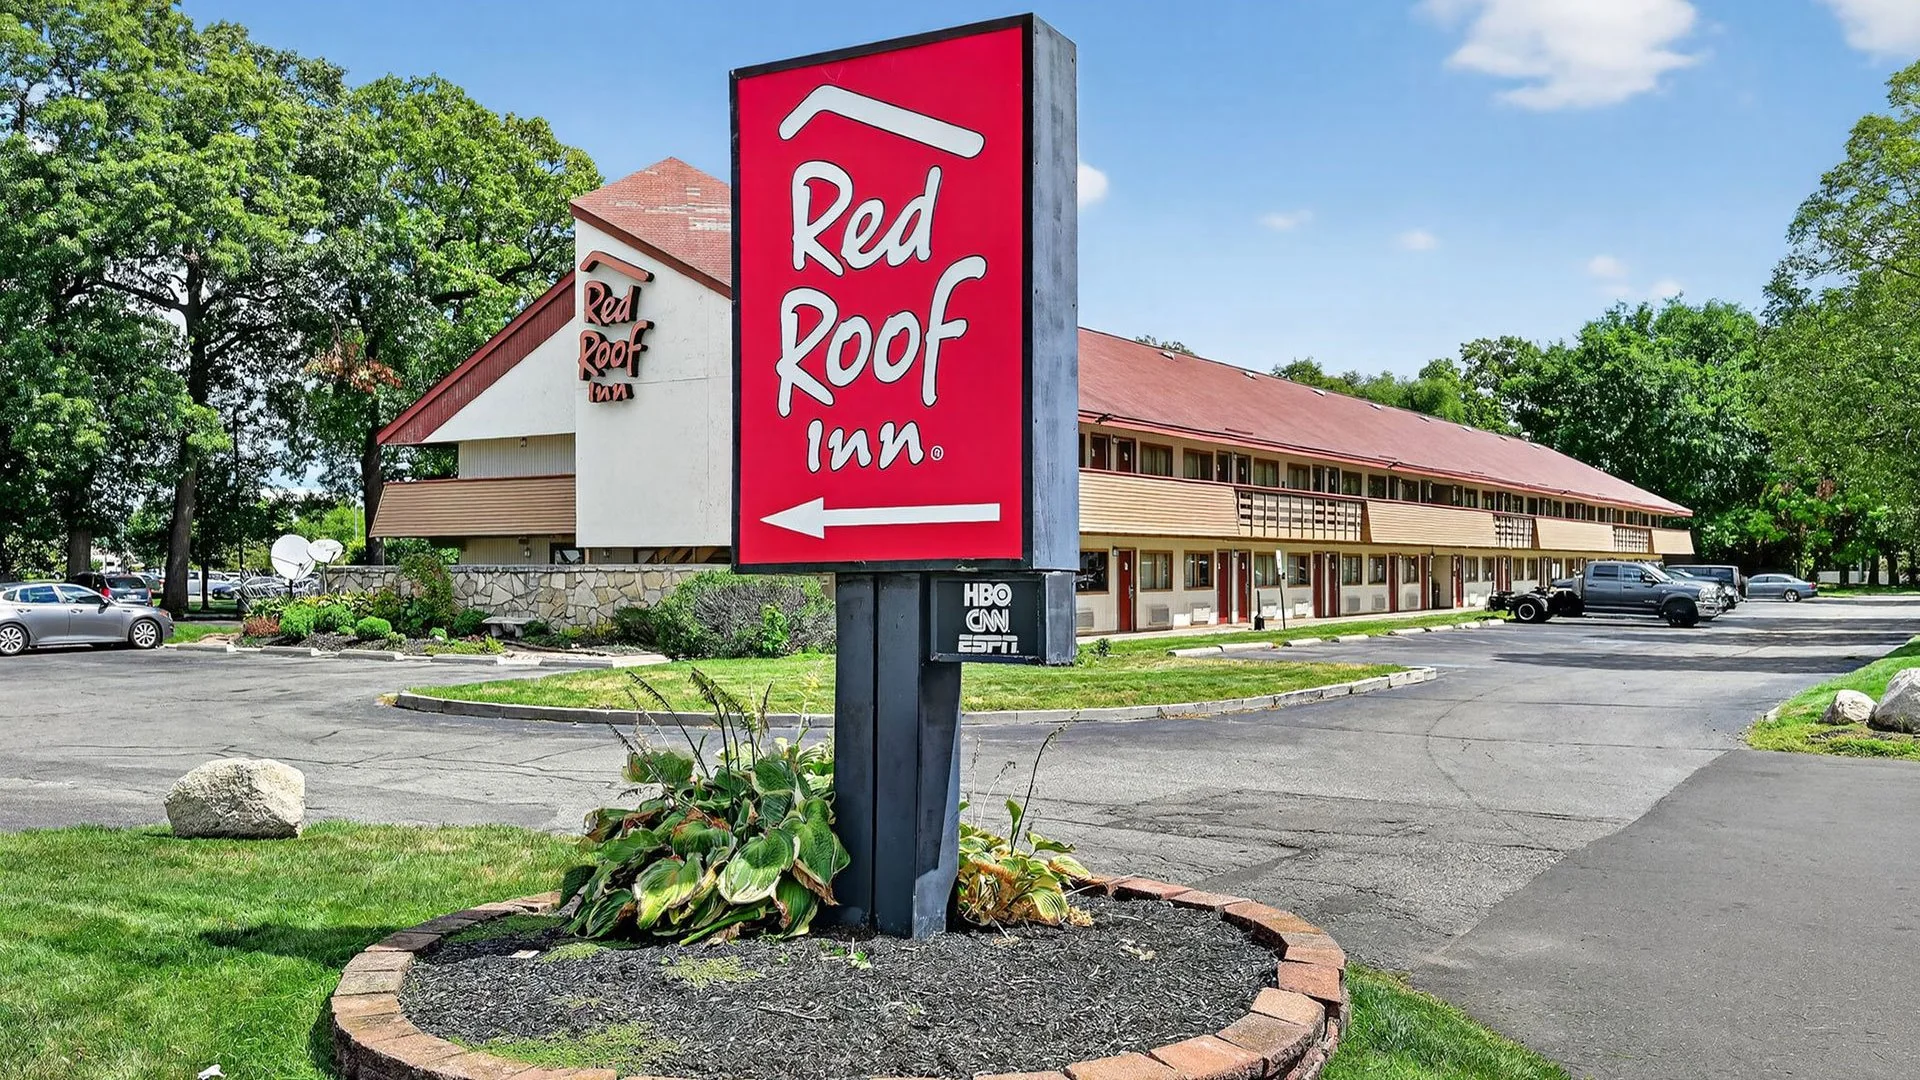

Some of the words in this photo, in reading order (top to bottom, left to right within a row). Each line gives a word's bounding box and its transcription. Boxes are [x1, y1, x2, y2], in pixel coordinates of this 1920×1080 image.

[791, 160, 942, 276] Red
[584, 280, 641, 327] Red
[578, 320, 654, 381] Roof
[775, 255, 988, 418] Roof
[963, 583, 1012, 607] HBO
[957, 634, 1018, 654] ESPN
[965, 608, 1010, 633] CNN
